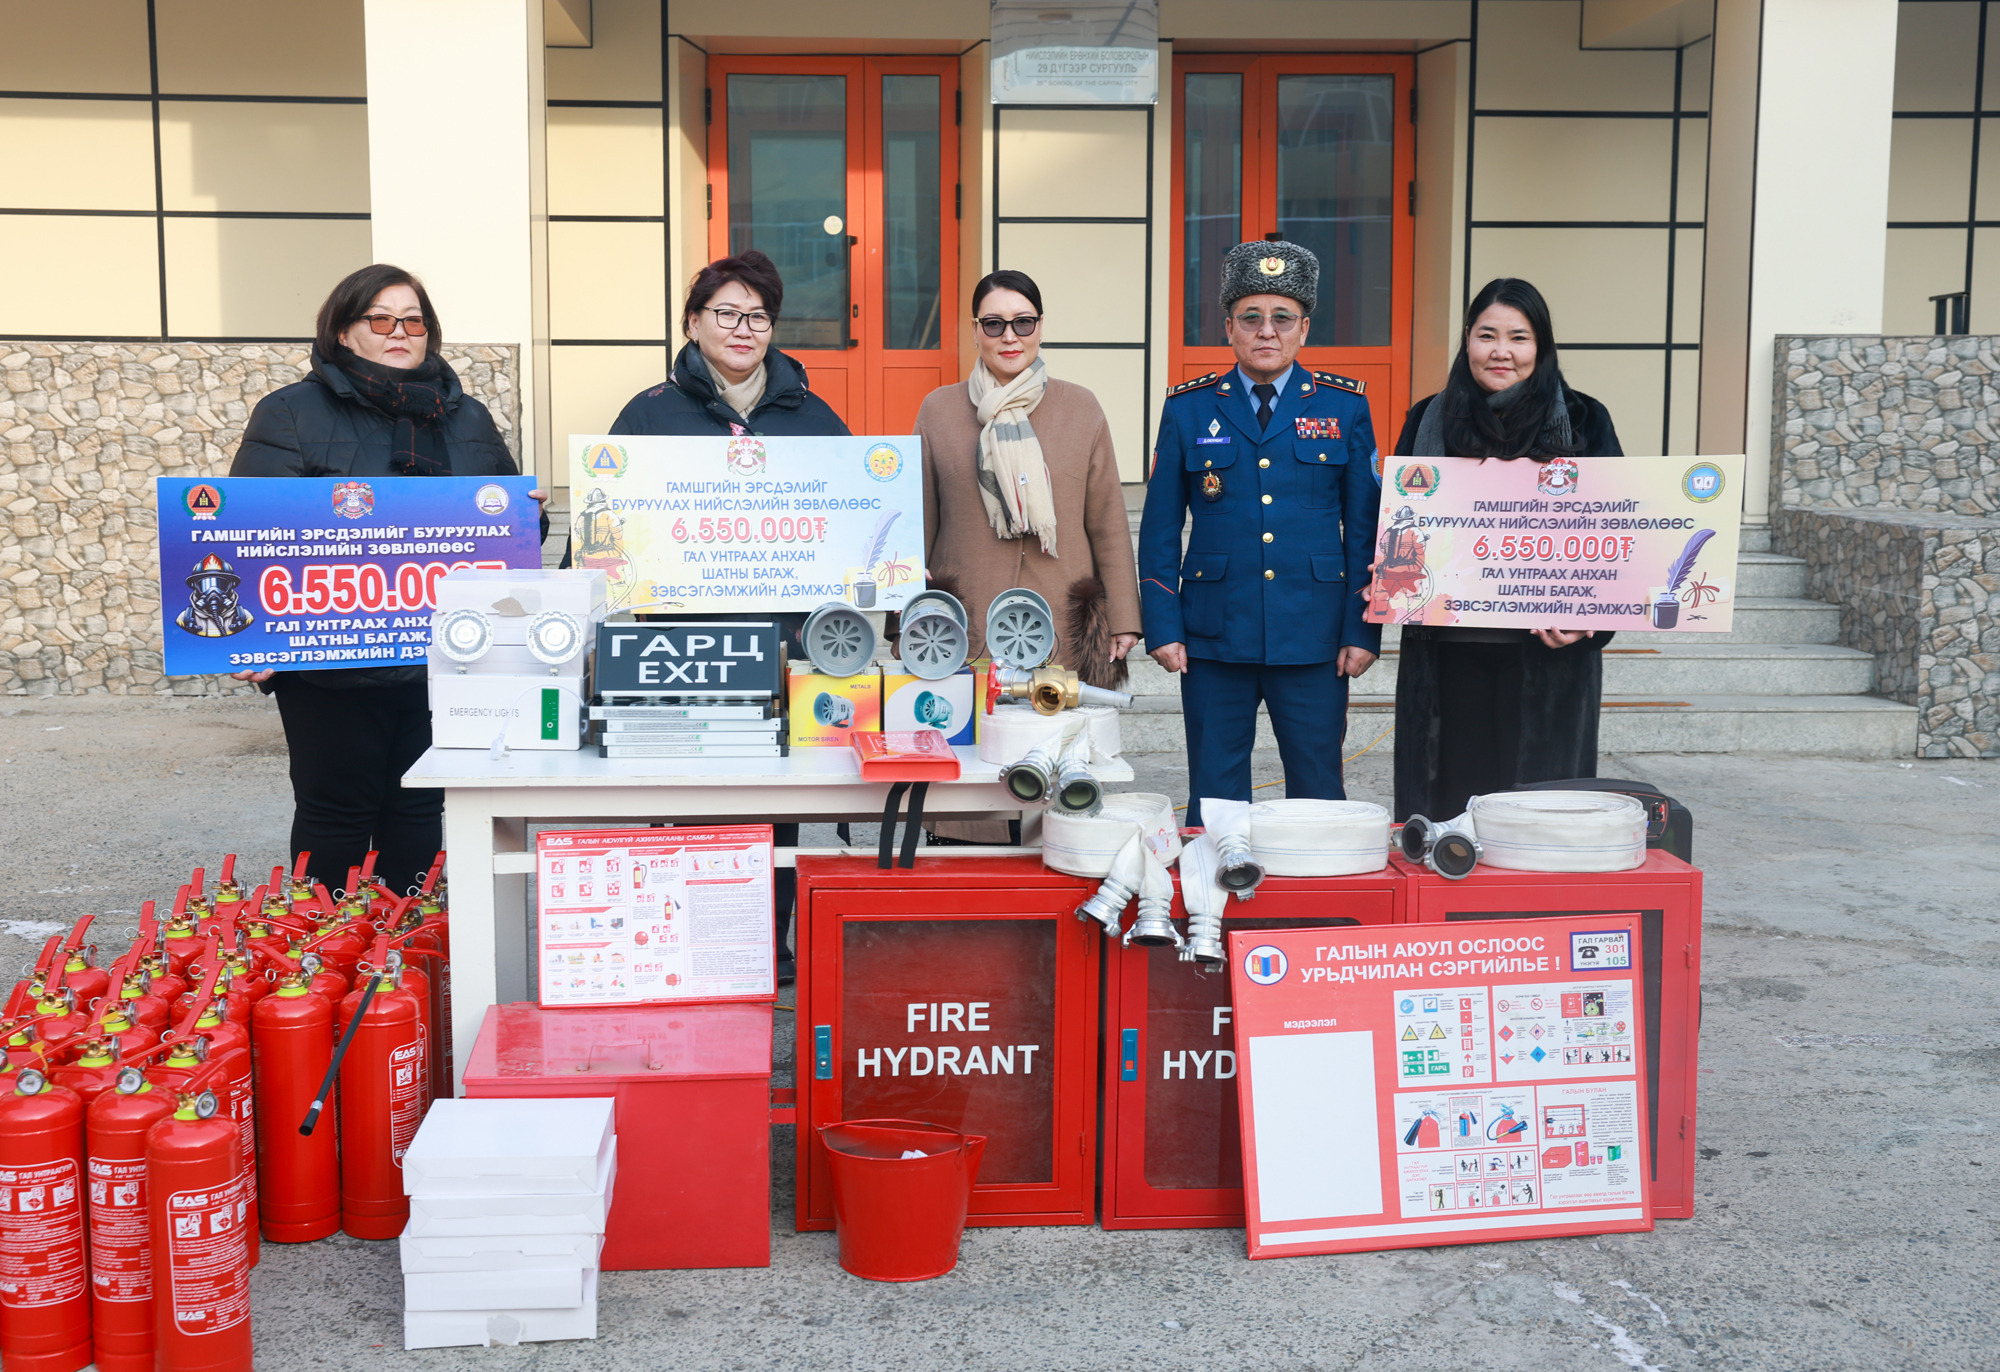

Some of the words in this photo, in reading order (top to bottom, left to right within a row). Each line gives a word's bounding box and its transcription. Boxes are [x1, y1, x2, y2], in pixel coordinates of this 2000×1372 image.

[1038, 64, 1048, 72] 29
[1090, 64, 1138, 72] СУРГУУЛЬ
[666, 481, 741, 494] ГАМШГИЙН
[745, 481, 828, 496] ЭРСДЭЛИЙГ
[612, 498, 690, 512] БУУРУУЛАХ
[695, 496, 790, 510] НИЙСЛЭЛИЙН
[793, 498, 882, 510] ЗӨВЛӨЛӨӨС
[1473, 500, 1548, 513] ГАМШГИЙН
[1553, 501, 1639, 516] ЭРСДЭЛИЙГ
[1418, 516, 1495, 530] БУУРУУЛАХ
[1499, 516, 1596, 530] НИЙСЛЭЛИЙН
[1600, 517, 1695, 530] ЗӨВЛӨЛӨӨС
[192, 528, 296, 542] ГАМШГИЙН
[301, 526, 408, 540] ЭРСДЭЛИЙГ
[414, 525, 511, 538] БУУРУУЛАХ
[236, 544, 363, 558] НИЙСЛЭЛИЙН
[368, 542, 476, 555] ЗӨВЛӨЛӨӨС
[684, 551, 707, 562] ГАЛ
[711, 551, 768, 562] УНТРААХ
[772, 550, 815, 562] АНХАН
[702, 568, 749, 580] ШАТНЫ
[753, 568, 798, 580] БАГАЖ,
[1482, 568, 1504, 580] ГАЛ
[1508, 568, 1567, 580] УНТРААХ
[1570, 568, 1618, 580] АНХАН
[259, 561, 506, 616] 6.550.00
[650, 584, 778, 598] ЗЭВСЭГЛЭМЖИЙН
[781, 584, 850, 598] ДЭМЖЛЭГ
[1498, 585, 1546, 597] ШАТНЫ
[1550, 585, 1598, 598] БАГАЖ,
[1444, 600, 1573, 614] ЗЭВСЭГЛЭМЖИЙН
[1577, 602, 1650, 618] ДЭМЖЛЭГ
[265, 620, 300, 633] ГАЛ
[306, 618, 388, 632] УНТРААХ
[290, 634, 358, 647] ШАТНЫ
[364, 631, 432, 646] БАГАЖ,
[611, 634, 764, 662] ГАРЦ
[229, 647, 395, 665] ЗЭВСЭГЛЭМЖИЙН
[638, 661, 737, 684] EXIT
[450, 708, 492, 716] EMERGENCY
[546, 838, 574, 846] EAS
[1316, 945, 1388, 962] ГАЛЫН
[1392, 940, 1454, 960] АЮУЛ
[1458, 936, 1545, 956] ОСЛООС
[1605, 944, 1624, 954] 301
[1606, 956, 1626, 966] 105
[1301, 964, 1424, 984] УРЬДЧИЛАН
[1428, 955, 1549, 978] СЭРГИЙЛЬЕ
[1555, 957, 1561, 971] !
[907, 1002, 990, 1032] FIRE
[1284, 1018, 1338, 1030] МЭДЭЭЛЭЛ
[395, 1046, 416, 1060] EAS
[857, 1045, 1040, 1078] HYDRANT
[0, 1170, 17, 1182] AS
[19, 1172, 33, 1180] ГАЛ
[90, 1162, 112, 1176] EAS
[173, 1194, 208, 1208] EAS
[210, 1192, 224, 1200] ГАЛ
[177, 1310, 206, 1322] EAS
